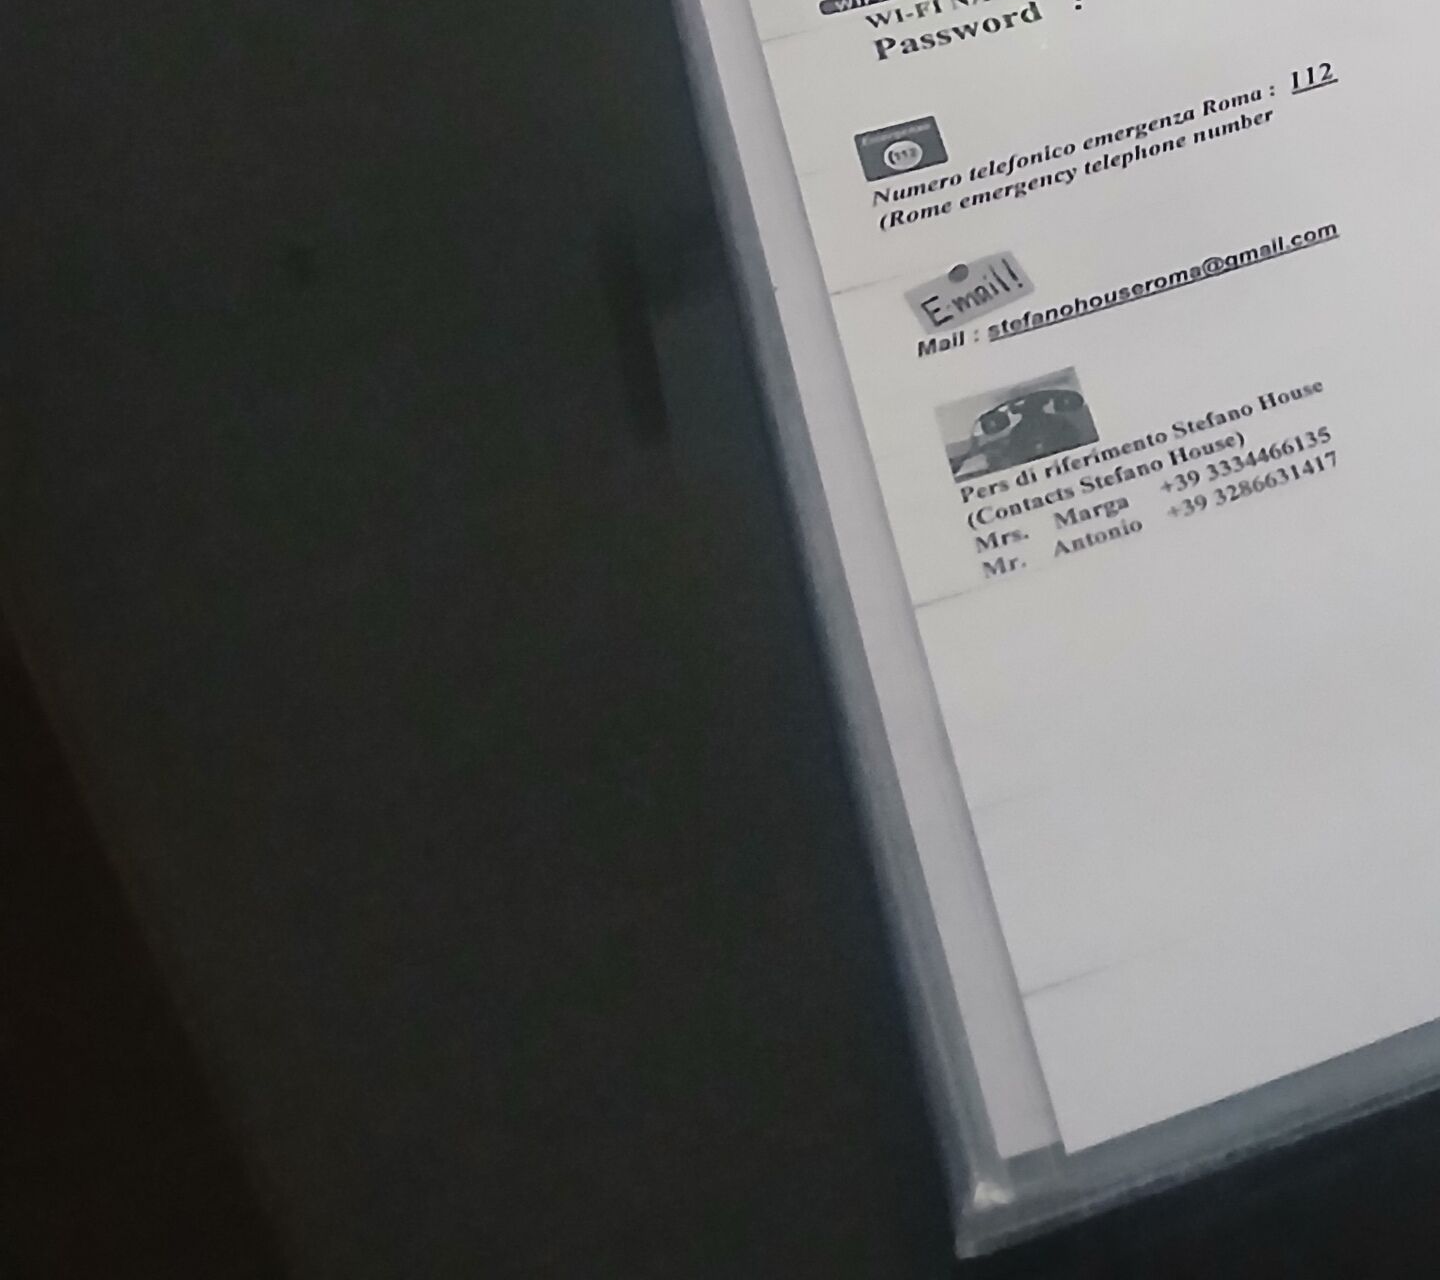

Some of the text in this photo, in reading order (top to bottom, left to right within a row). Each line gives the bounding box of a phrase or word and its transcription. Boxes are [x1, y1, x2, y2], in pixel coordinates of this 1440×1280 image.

[866, 0, 944, 29] WI-FI
[874, 1, 1043, 61] Password
[872, 171, 962, 207] Numero
[969, 141, 1076, 184] telefonico
[1082, 107, 1195, 152] emergenza
[1202, 87, 1262, 117] Roma
[1290, 62, 1337, 94] 112
[879, 109, 1273, 231] (Rome emergency telephone number
[917, 332, 965, 359] Mail
[988, 222, 1339, 341] stefanohouseroma@gmail.com
[960, 379, 1324, 505] Pers di riferimento Stefano House
[967, 430, 1245, 530] (Contacts Stefano House)
[975, 426, 1332, 553] Mrs. Marga +39 3334466135
[982, 450, 1338, 579] Mr. Antonio +39 3286631417
